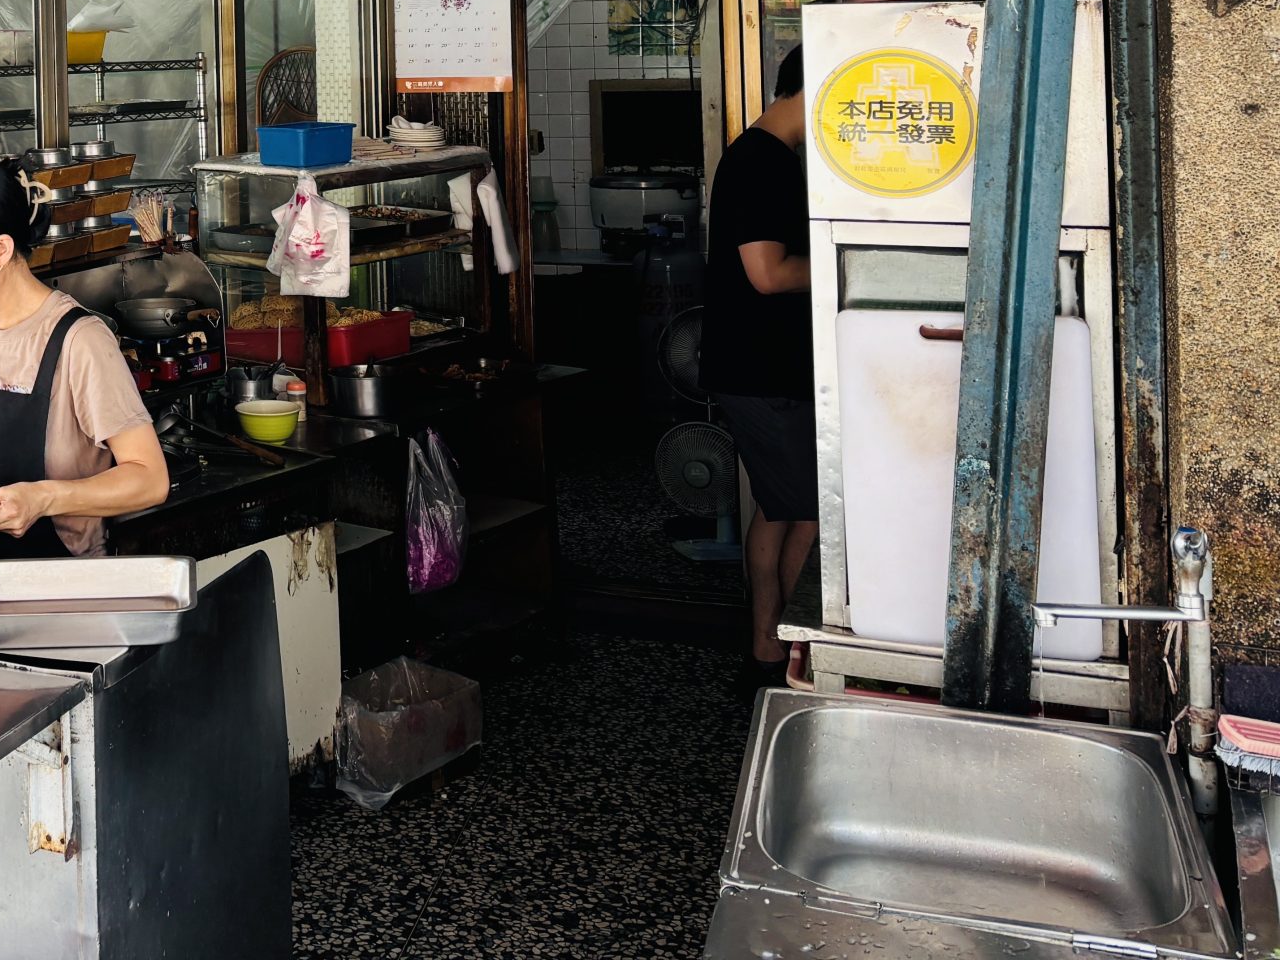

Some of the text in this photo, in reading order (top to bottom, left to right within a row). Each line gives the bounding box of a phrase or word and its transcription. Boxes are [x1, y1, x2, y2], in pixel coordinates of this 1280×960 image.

[837, 99, 954, 121] 本店免用
[837, 121, 956, 144] 統一發票
